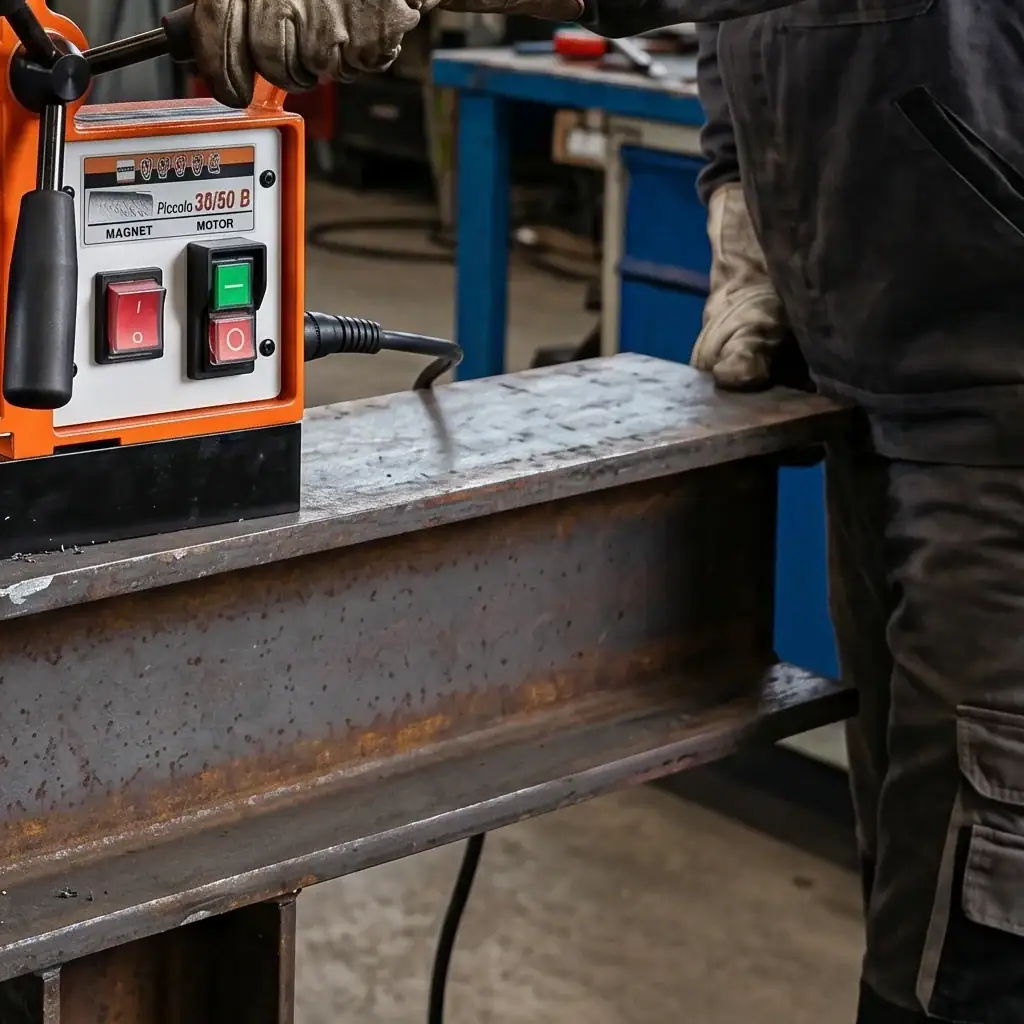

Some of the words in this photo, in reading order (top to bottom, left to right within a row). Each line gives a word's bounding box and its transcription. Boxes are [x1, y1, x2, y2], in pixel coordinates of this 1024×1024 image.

[157, 200, 193, 215] Piccolo
[194, 190, 235, 212] 30/50
[240, 188, 250, 208] B
[105, 225, 153, 240] MAGNET
[196, 218, 234, 232] MOTOR
